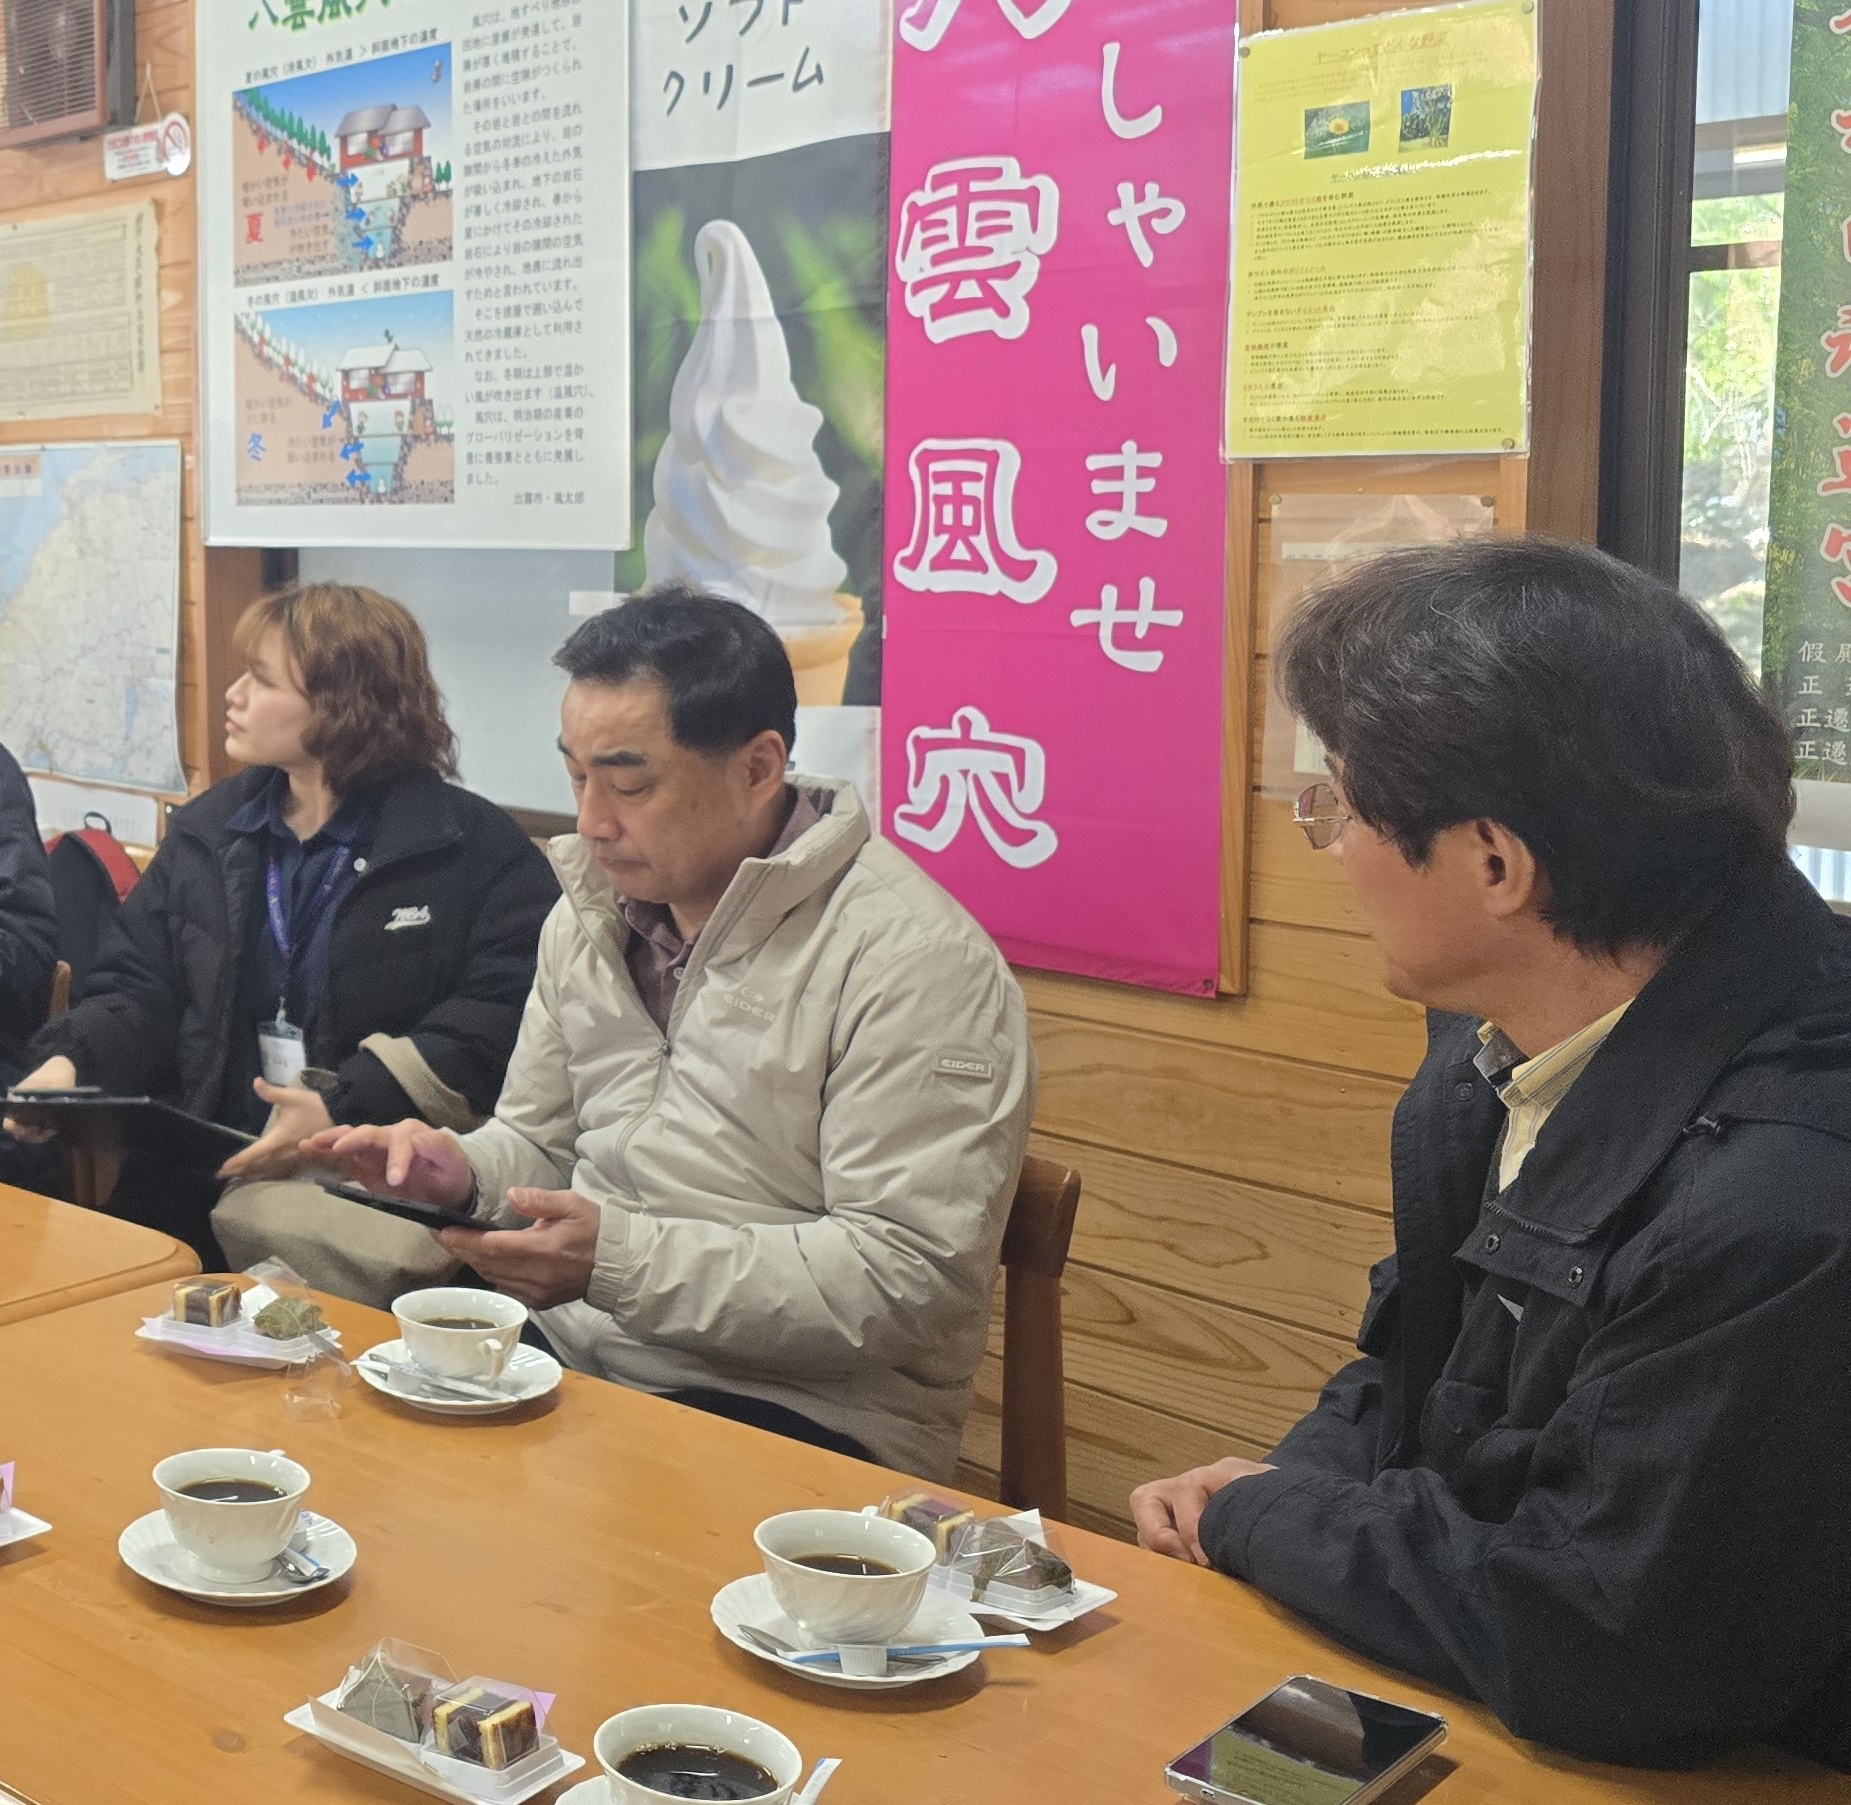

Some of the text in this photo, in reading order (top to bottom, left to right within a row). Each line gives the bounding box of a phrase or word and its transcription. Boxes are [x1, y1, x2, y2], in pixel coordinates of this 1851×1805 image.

[678, 0, 802, 44] ソフト
[663, 46, 825, 117] クリーム
[246, 213, 263, 245] 夏
[1071, 40, 1187, 673] しゃいませ
[247, 433, 266, 462] 冬
